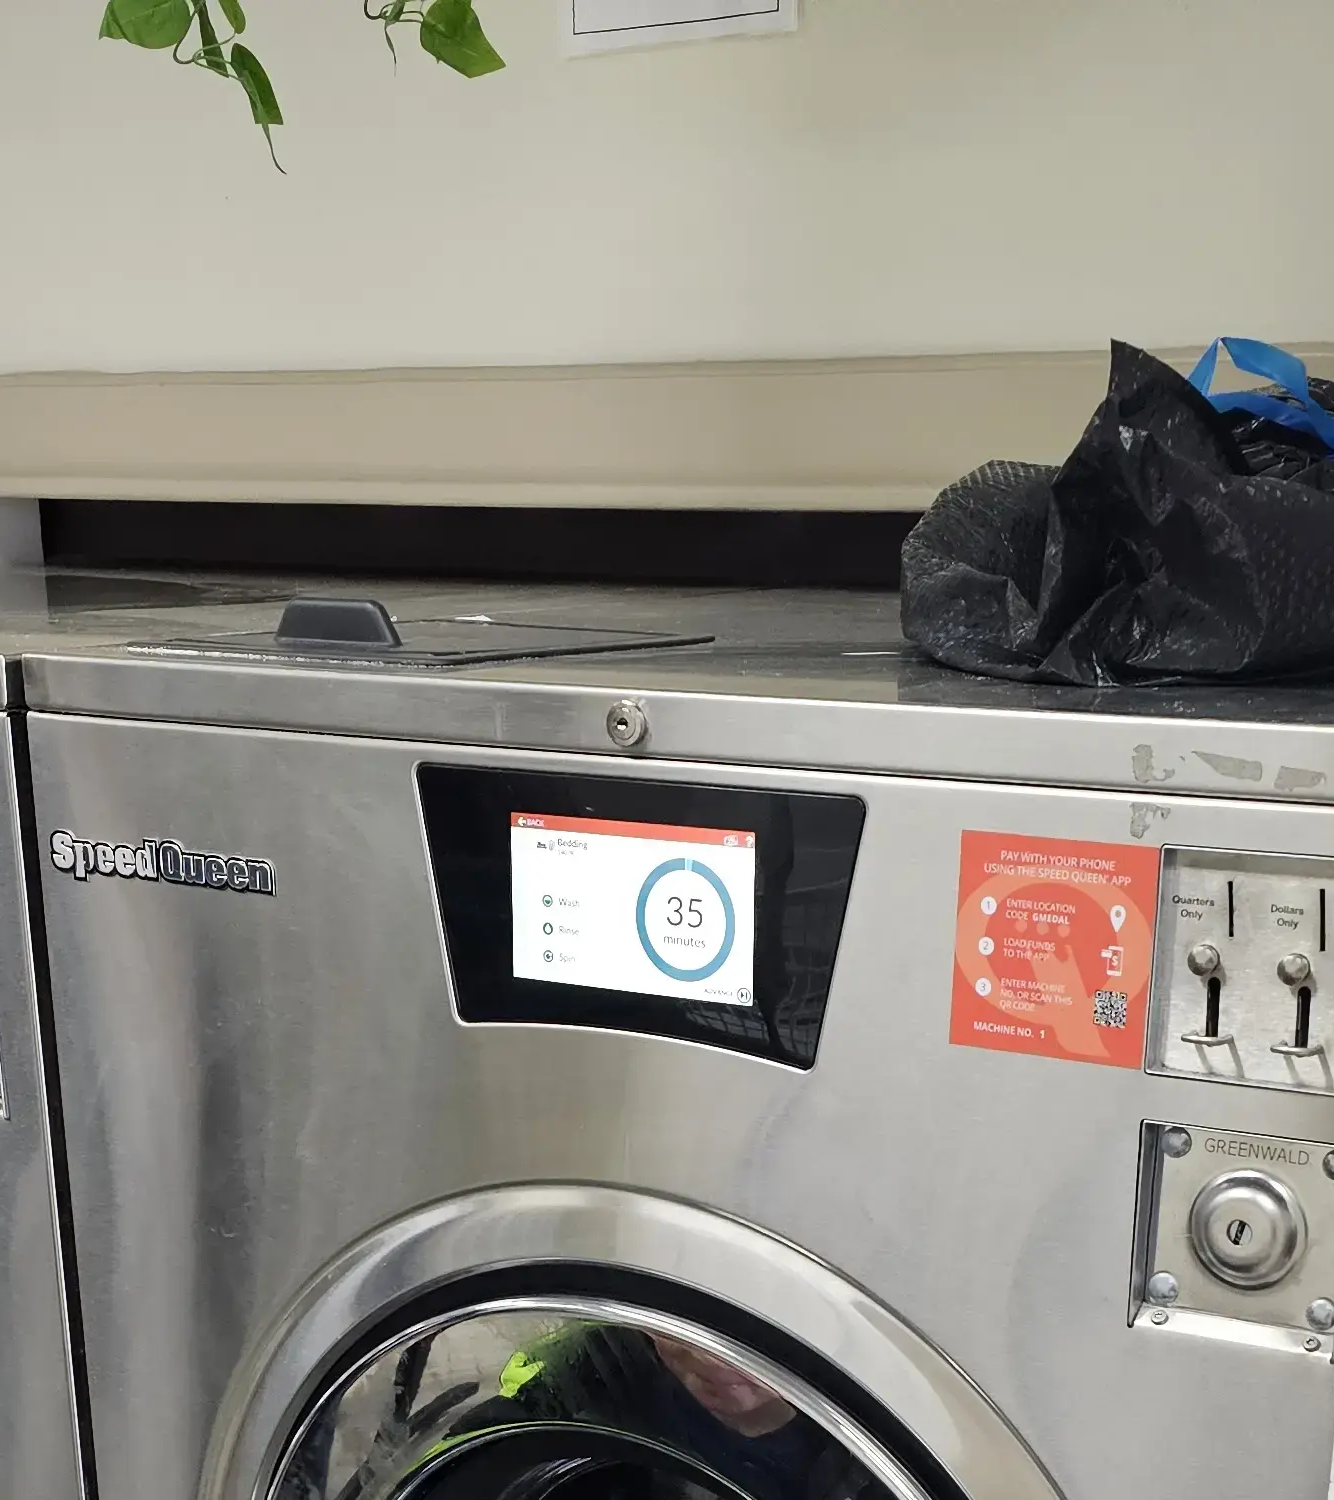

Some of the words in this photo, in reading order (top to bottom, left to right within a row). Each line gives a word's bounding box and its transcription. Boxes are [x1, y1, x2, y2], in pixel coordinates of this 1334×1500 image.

[527, 817, 545, 827] BACK
[557, 838, 587, 850] Bedding
[50, 829, 159, 882] Speed
[159, 838, 276, 896] Queen
[1001, 850, 1019, 860] PAY
[1020, 852, 1047, 864] WITH
[1048, 855, 1077, 868] YOUR
[1079, 858, 1115, 872] PHONE
[984, 863, 1015, 876] USING
[1017, 866, 1037, 878] THE
[1037, 868, 1069, 880] SPEED
[1111, 876, 1131, 886] APP
[559, 897, 579, 908] Wash
[1006, 898, 1033, 910] ENTER
[1033, 900, 1075, 914] LOCATION
[1171, 894, 1215, 907] Quarters
[667, 896, 703, 928] 35
[1005, 910, 1029, 921] CODE
[1181, 908, 1203, 920] Only
[1271, 904, 1304, 916] Dollars
[1277, 918, 1299, 930] Only
[663, 936, 705, 948] minutes
[1003, 937, 1027, 949] LOAD
[1027, 940, 1055, 951] FUNDS
[559, 953, 575, 962] Spin
[1003, 948, 1015, 958] TO
[1016, 950, 1033, 960] THE
[1033, 952, 1051, 962] APP
[1001, 978, 1027, 989] ENTER
[1017, 991, 1029, 1000] OR
[1030, 992, 1052, 1004] SCAN
[999, 999, 1013, 1010] QR
[1013, 1001, 1035, 1012] CODE
[973, 1021, 1016, 1036] MACHINE
[1017, 1026, 1034, 1038] NO.
[1205, 1138, 1310, 1166] GREENWALD
